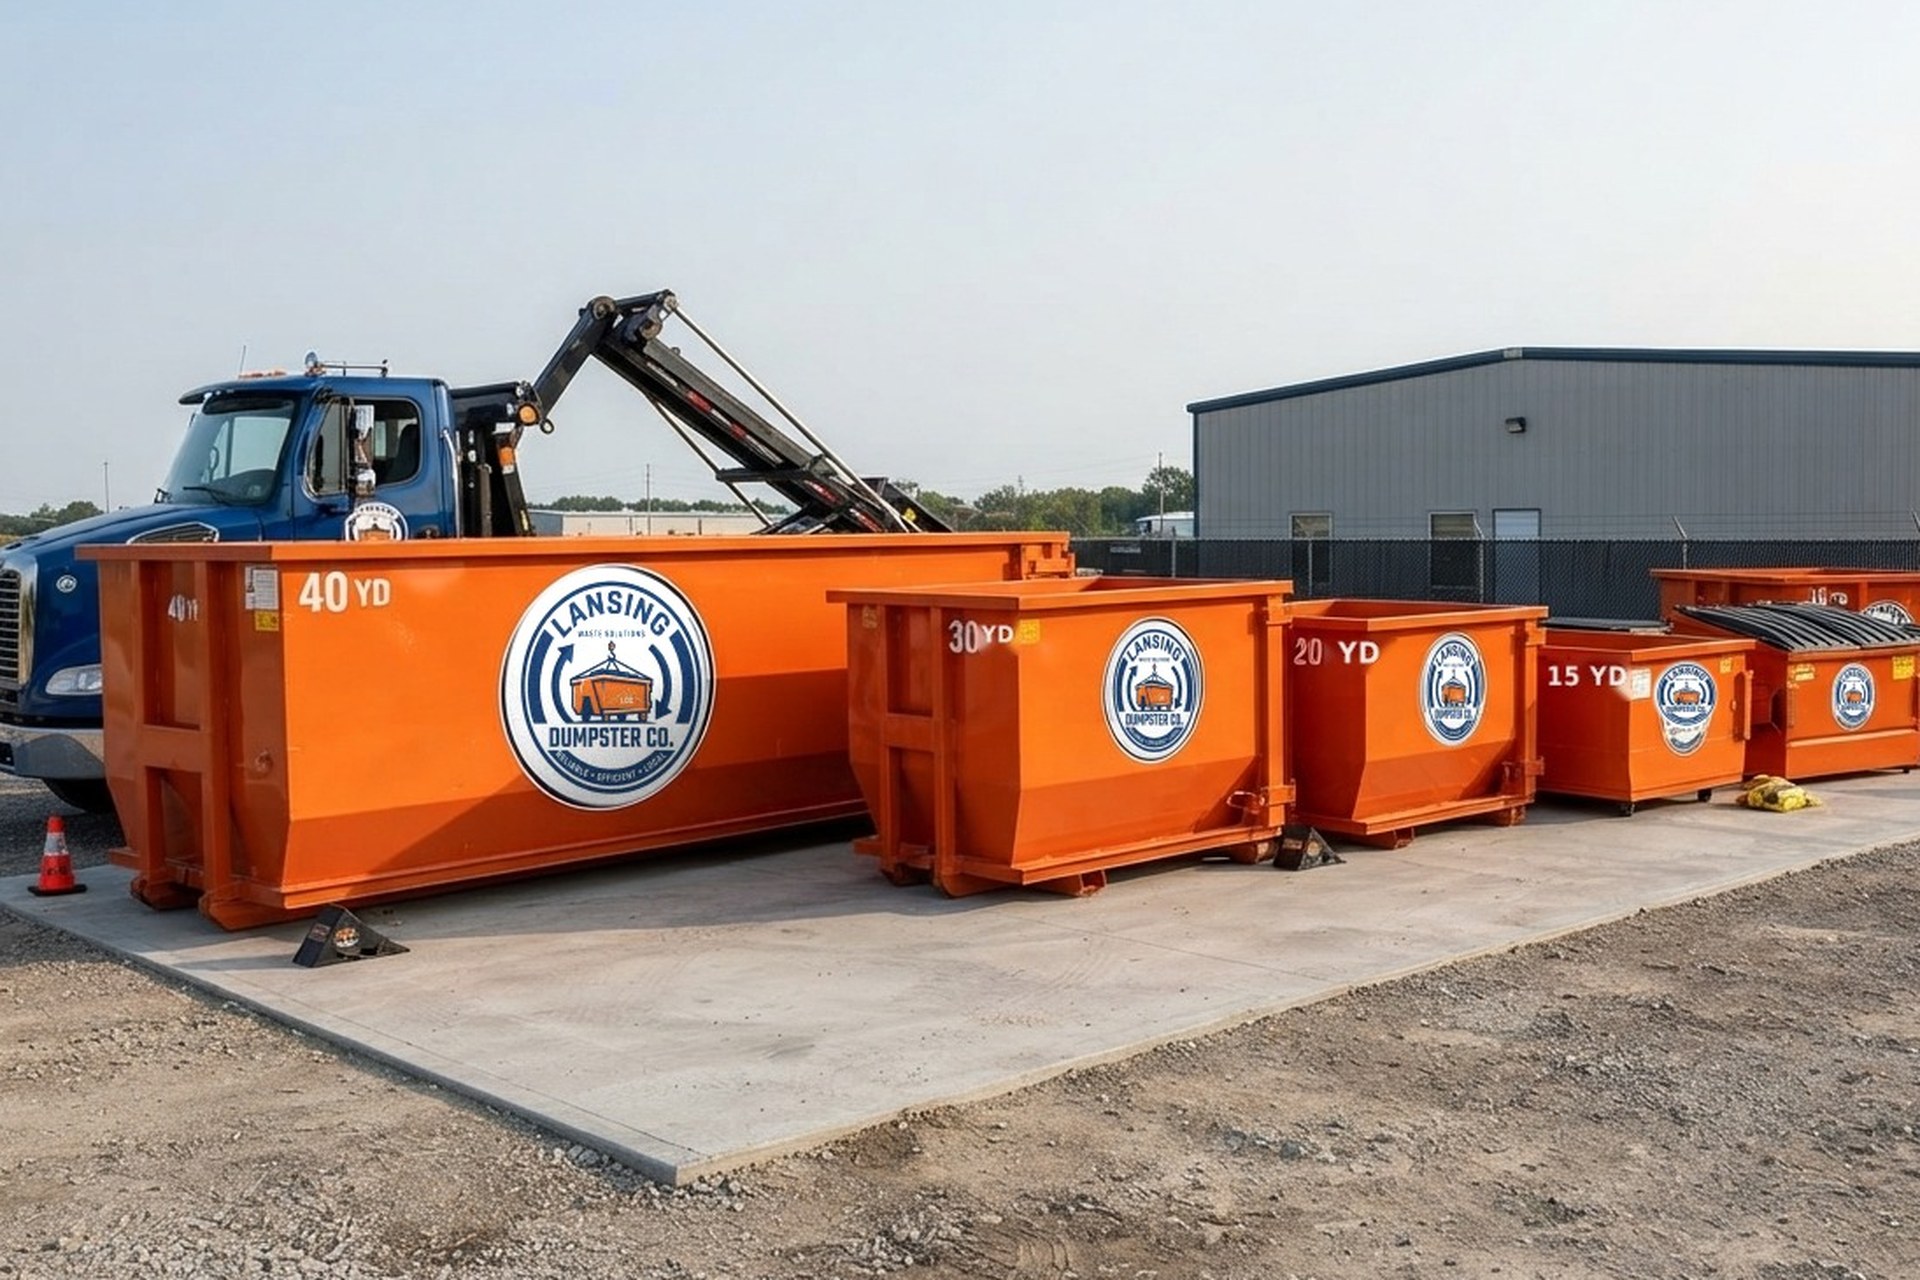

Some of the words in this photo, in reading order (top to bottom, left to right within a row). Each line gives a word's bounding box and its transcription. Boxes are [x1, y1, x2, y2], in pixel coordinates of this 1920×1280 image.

[300, 570, 348, 613] 40
[355, 578, 391, 607] YD
[551, 590, 670, 638] LANSING
[578, 629, 602, 638] WASTE
[949, 620, 978, 654] 30
[981, 624, 1014, 643] YD
[1127, 634, 1182, 662] LANSING
[1293, 637, 1323, 666] 20
[1338, 641, 1380, 664] YD
[1548, 666, 1579, 686] 15
[1589, 666, 1628, 686] YD
[1125, 713, 1169, 726] DUMPSTER
[548, 726, 641, 748] DUMPSTER
[646, 726, 674, 748] CO.
[555, 751, 589, 778] RELIABLE
[597, 771, 637, 783] EFFICIENT
[644, 752, 667, 773] LOCAL
